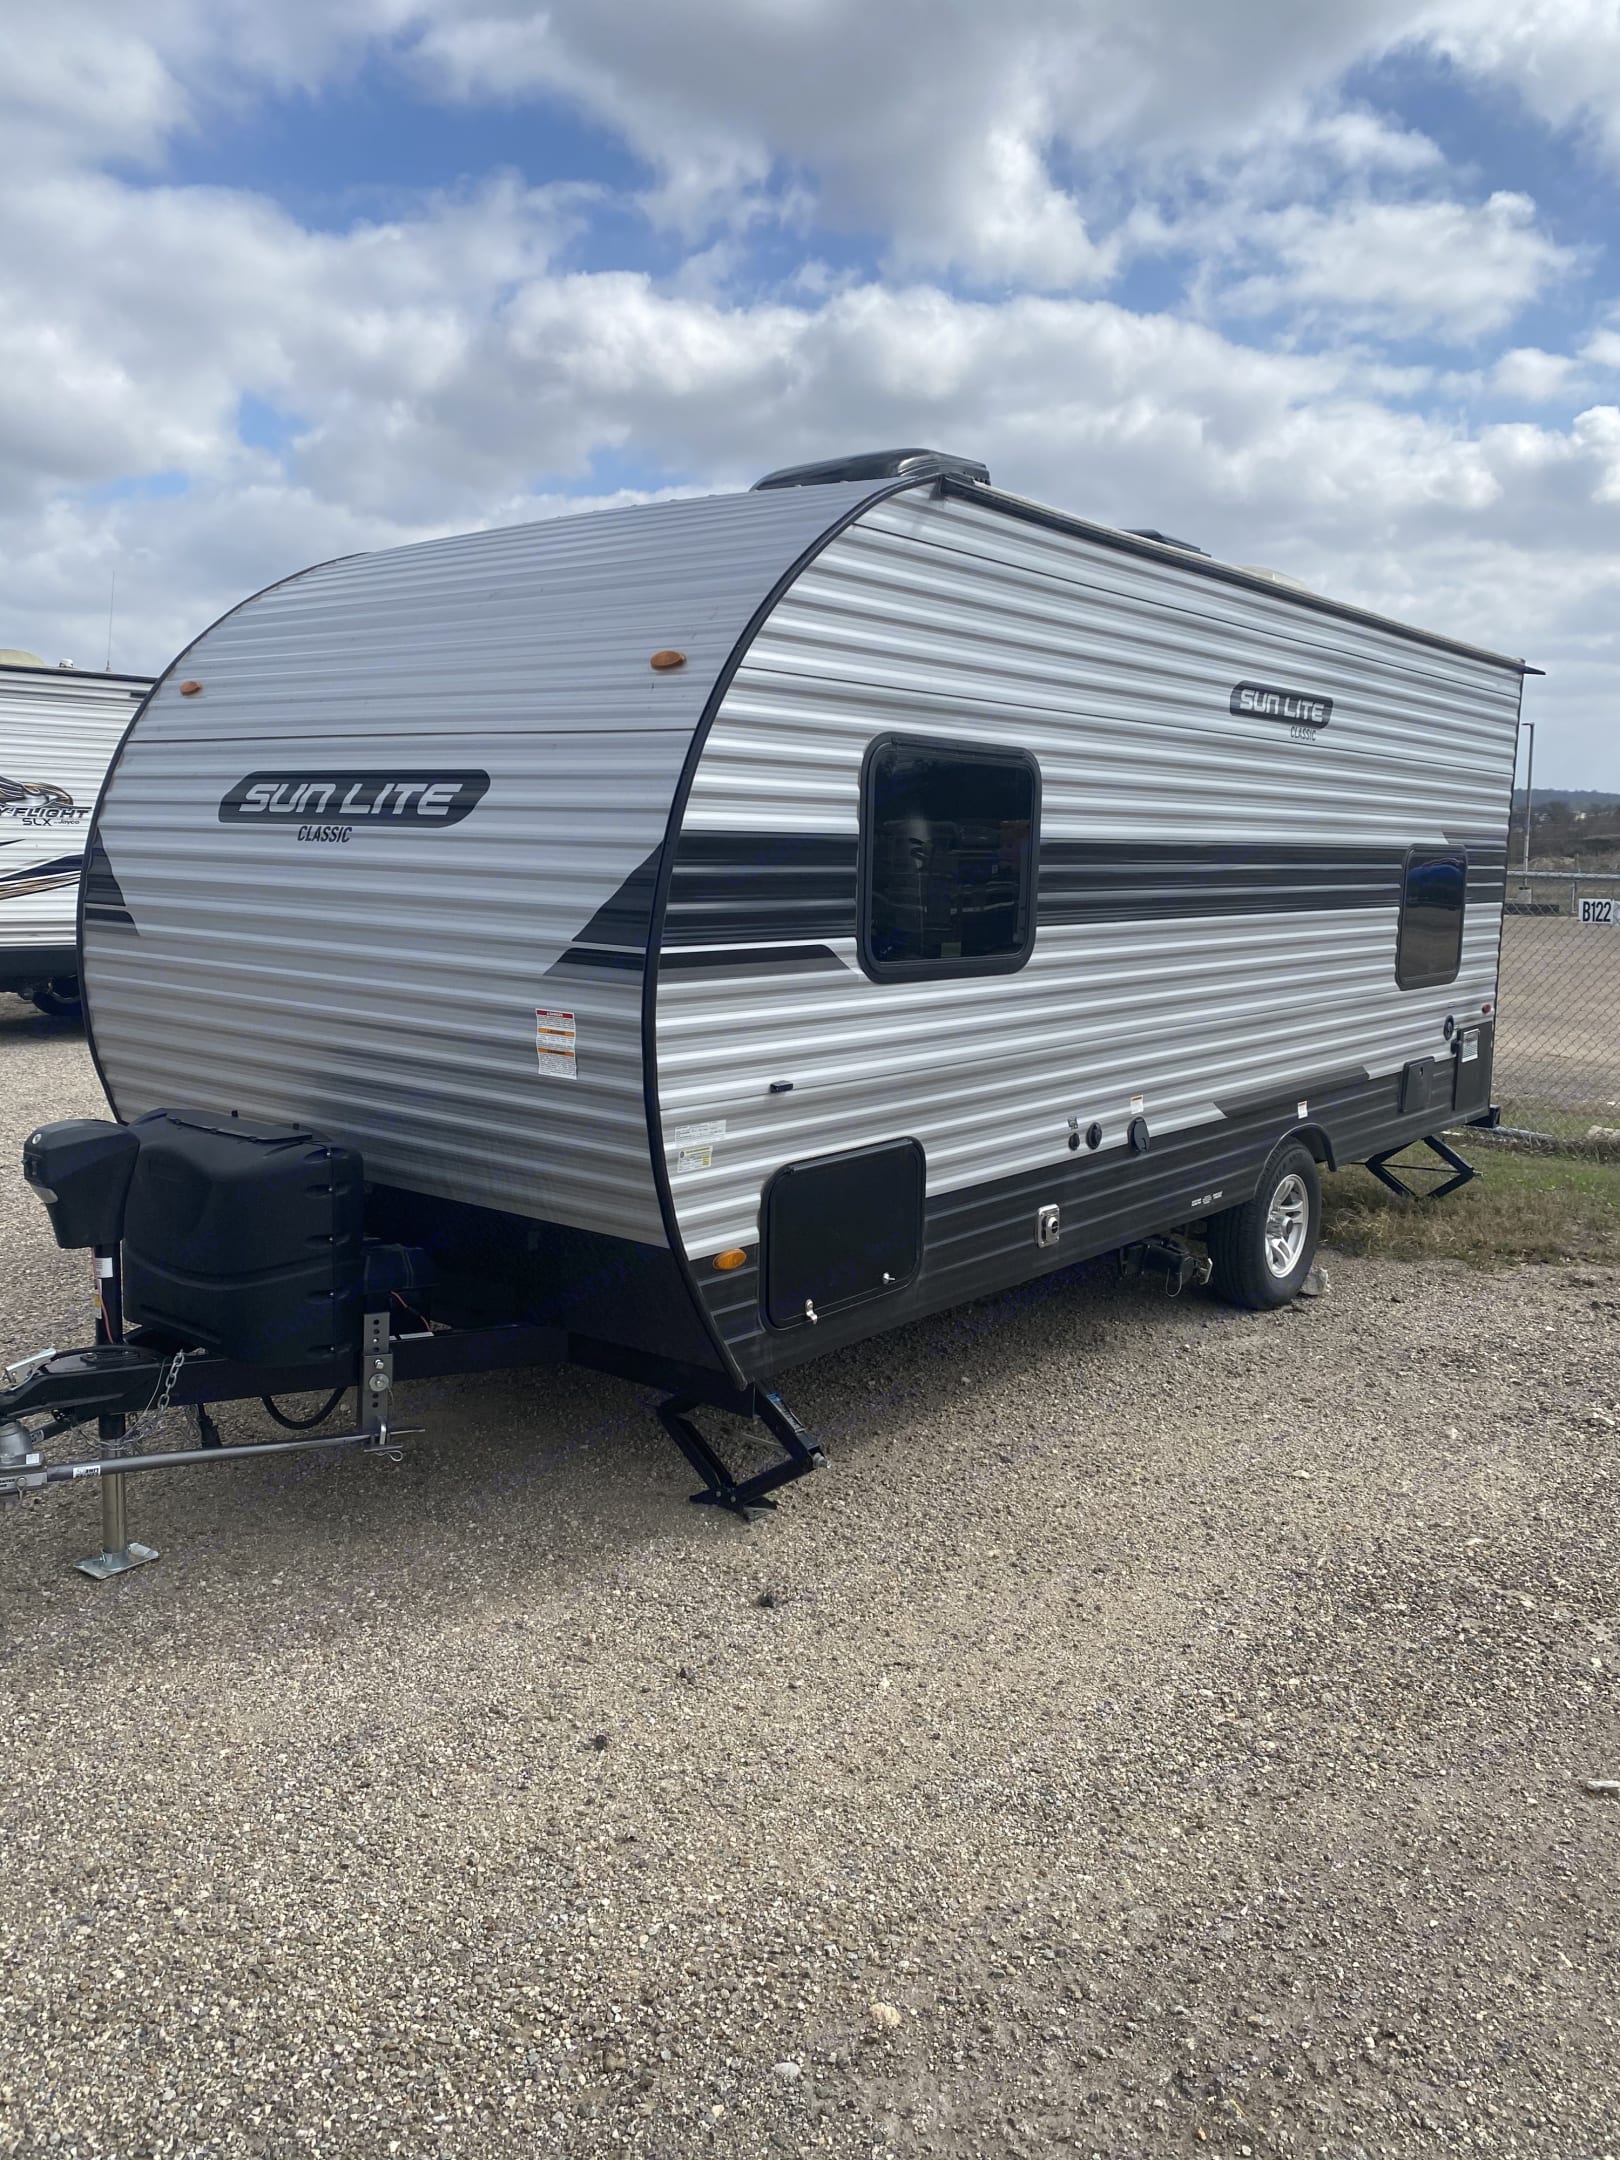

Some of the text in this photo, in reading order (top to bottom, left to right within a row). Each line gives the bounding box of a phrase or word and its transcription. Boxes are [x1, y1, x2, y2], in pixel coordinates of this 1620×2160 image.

[1240, 689, 1325, 722] SUN LITE
[1290, 726, 1317, 741] CLASSIC
[239, 783, 463, 816] SUN LITE
[22, 818, 52, 826] SLX
[297, 825, 352, 843] CLASSIC
[1582, 901, 1611, 922] B122
